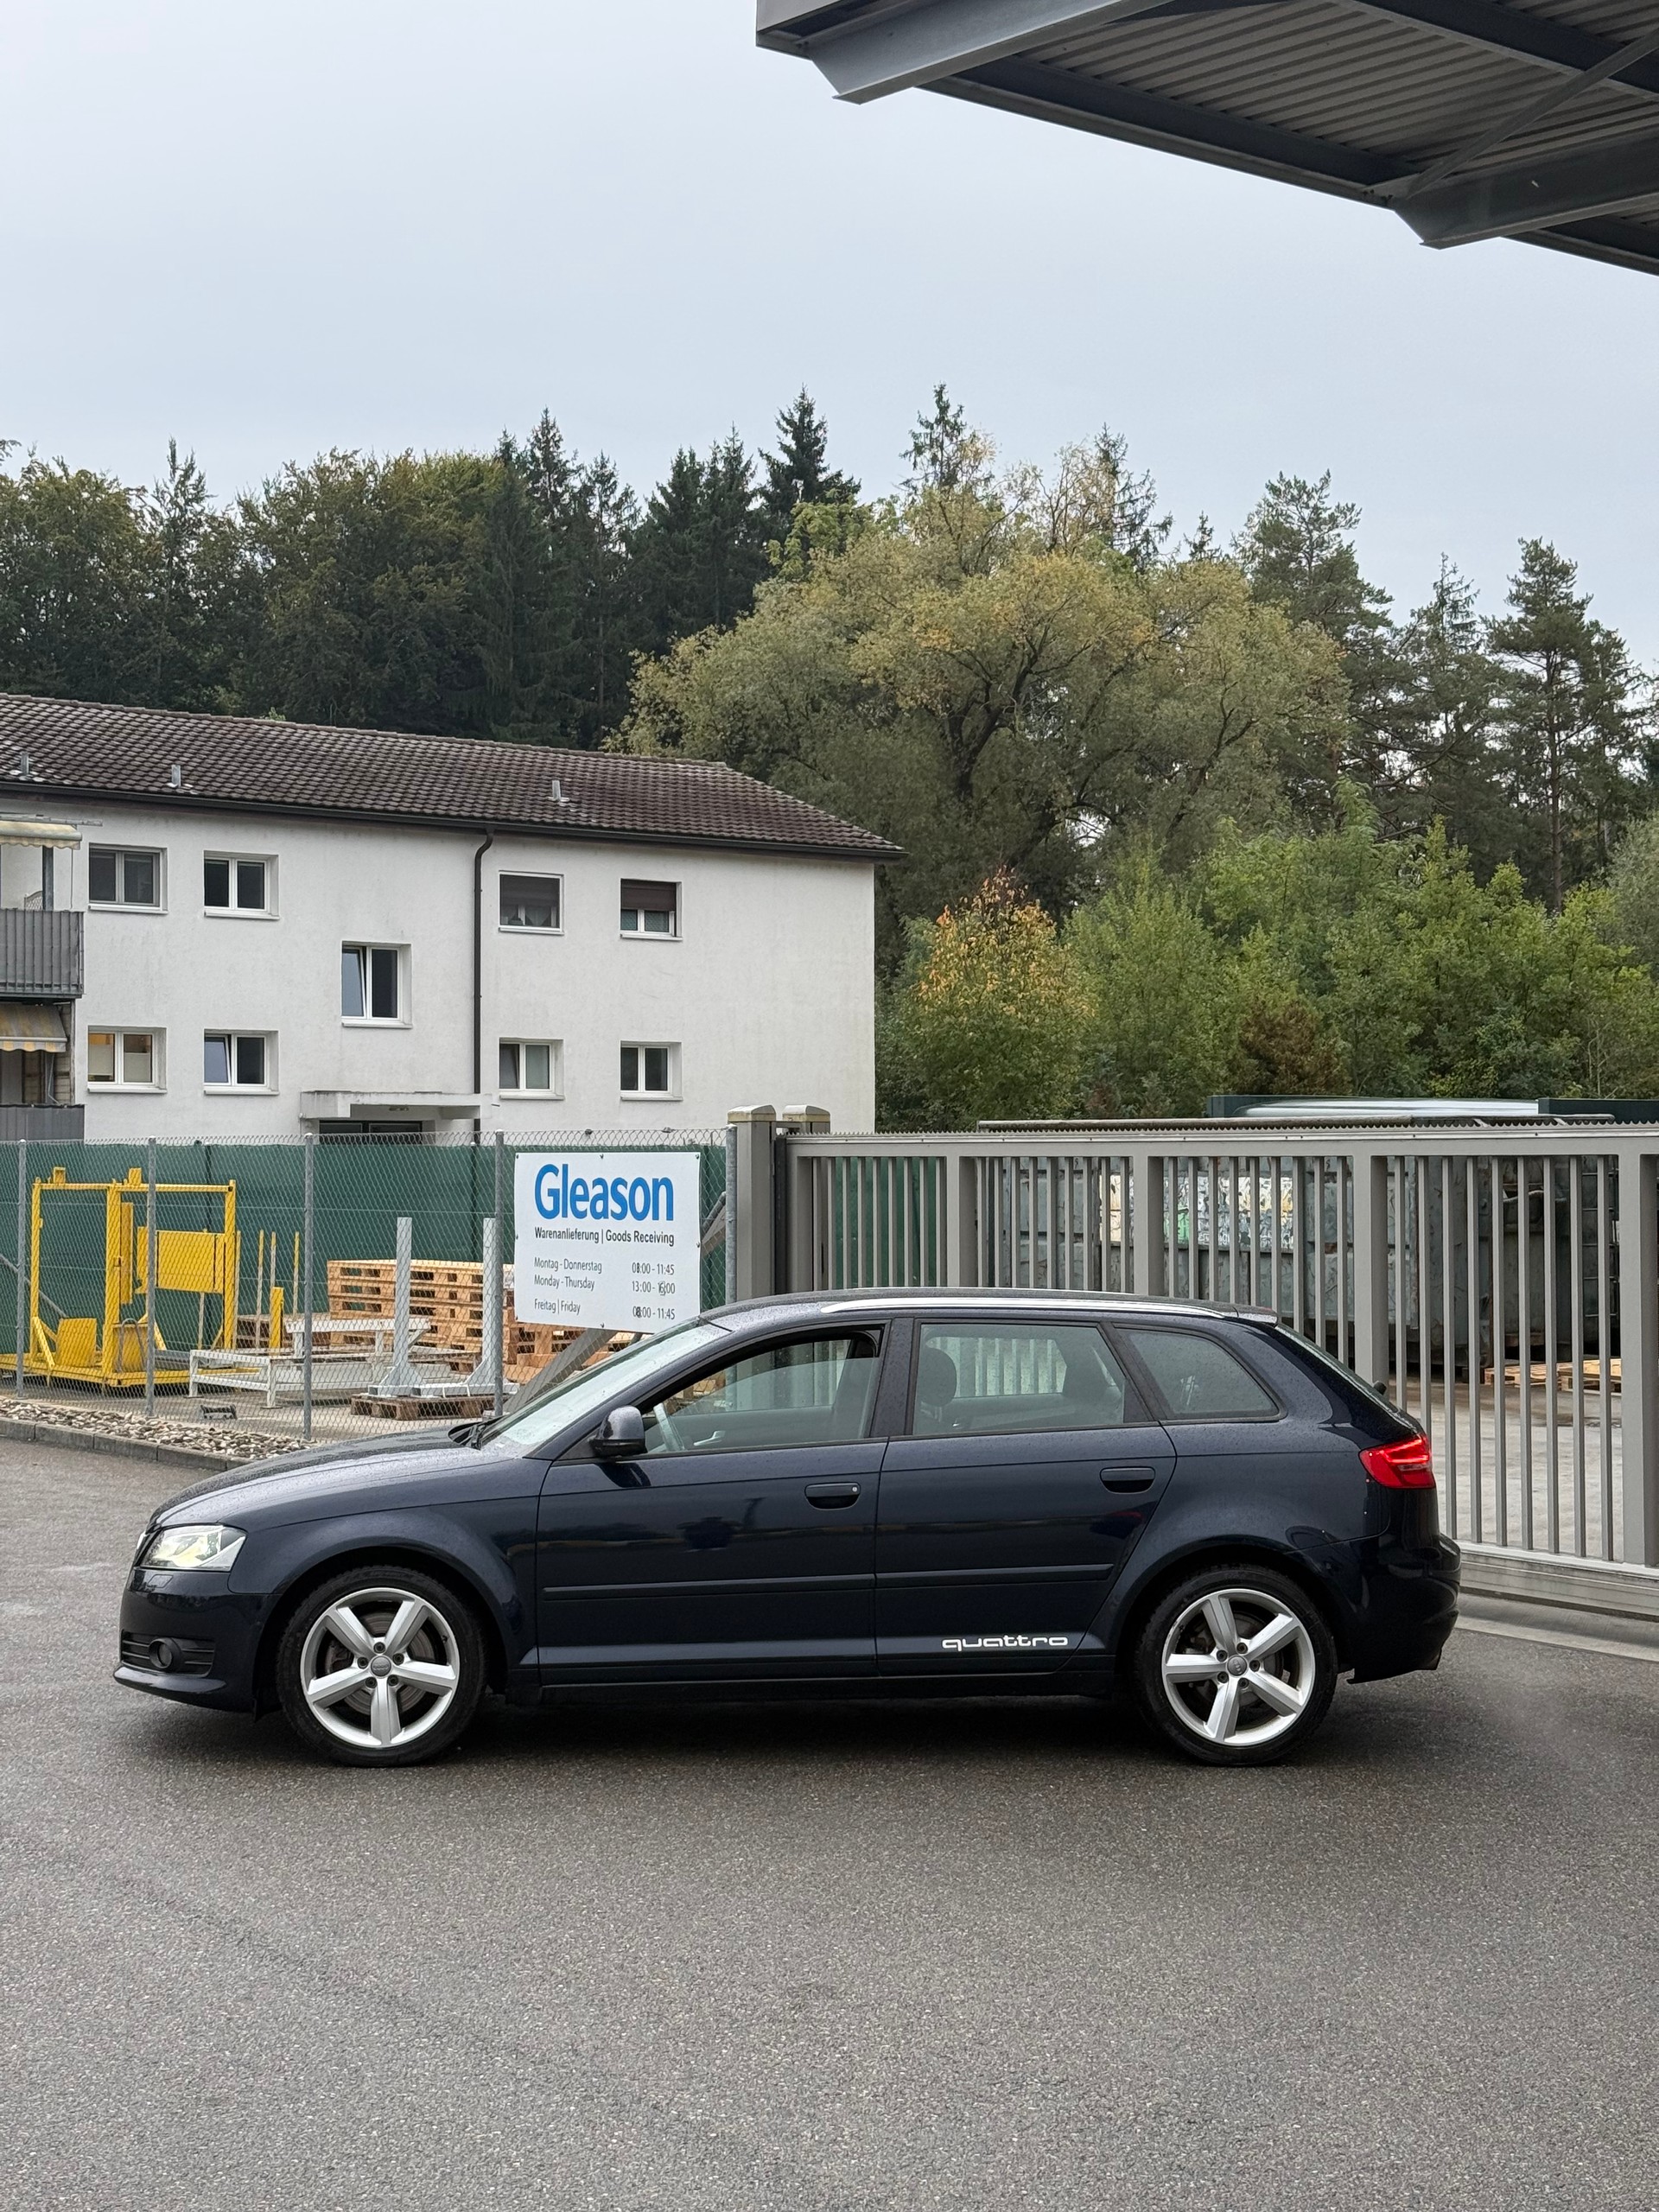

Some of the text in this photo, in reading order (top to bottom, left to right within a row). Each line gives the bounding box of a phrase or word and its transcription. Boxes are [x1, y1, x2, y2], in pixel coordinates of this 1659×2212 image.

[534, 1164, 674, 1221] Gleason
[534, 1226, 599, 1244] Warenanlieferung
[606, 1229, 632, 1243] Goods
[633, 1230, 674, 1247] Receiving
[534, 1256, 559, 1272] Montag
[563, 1258, 602, 1274] Donnerstag
[632, 1262, 651, 1274] 08:00
[657, 1262, 675, 1275] 11:45
[534, 1274, 560, 1289] Monday
[564, 1275, 594, 1292] Thursday
[632, 1281, 652, 1293] 13:00
[534, 1298, 556, 1313] Freitag
[561, 1300, 581, 1315] Friday
[658, 1307, 676, 1320] 11:45
[942, 1635, 1068, 1652] quattro
